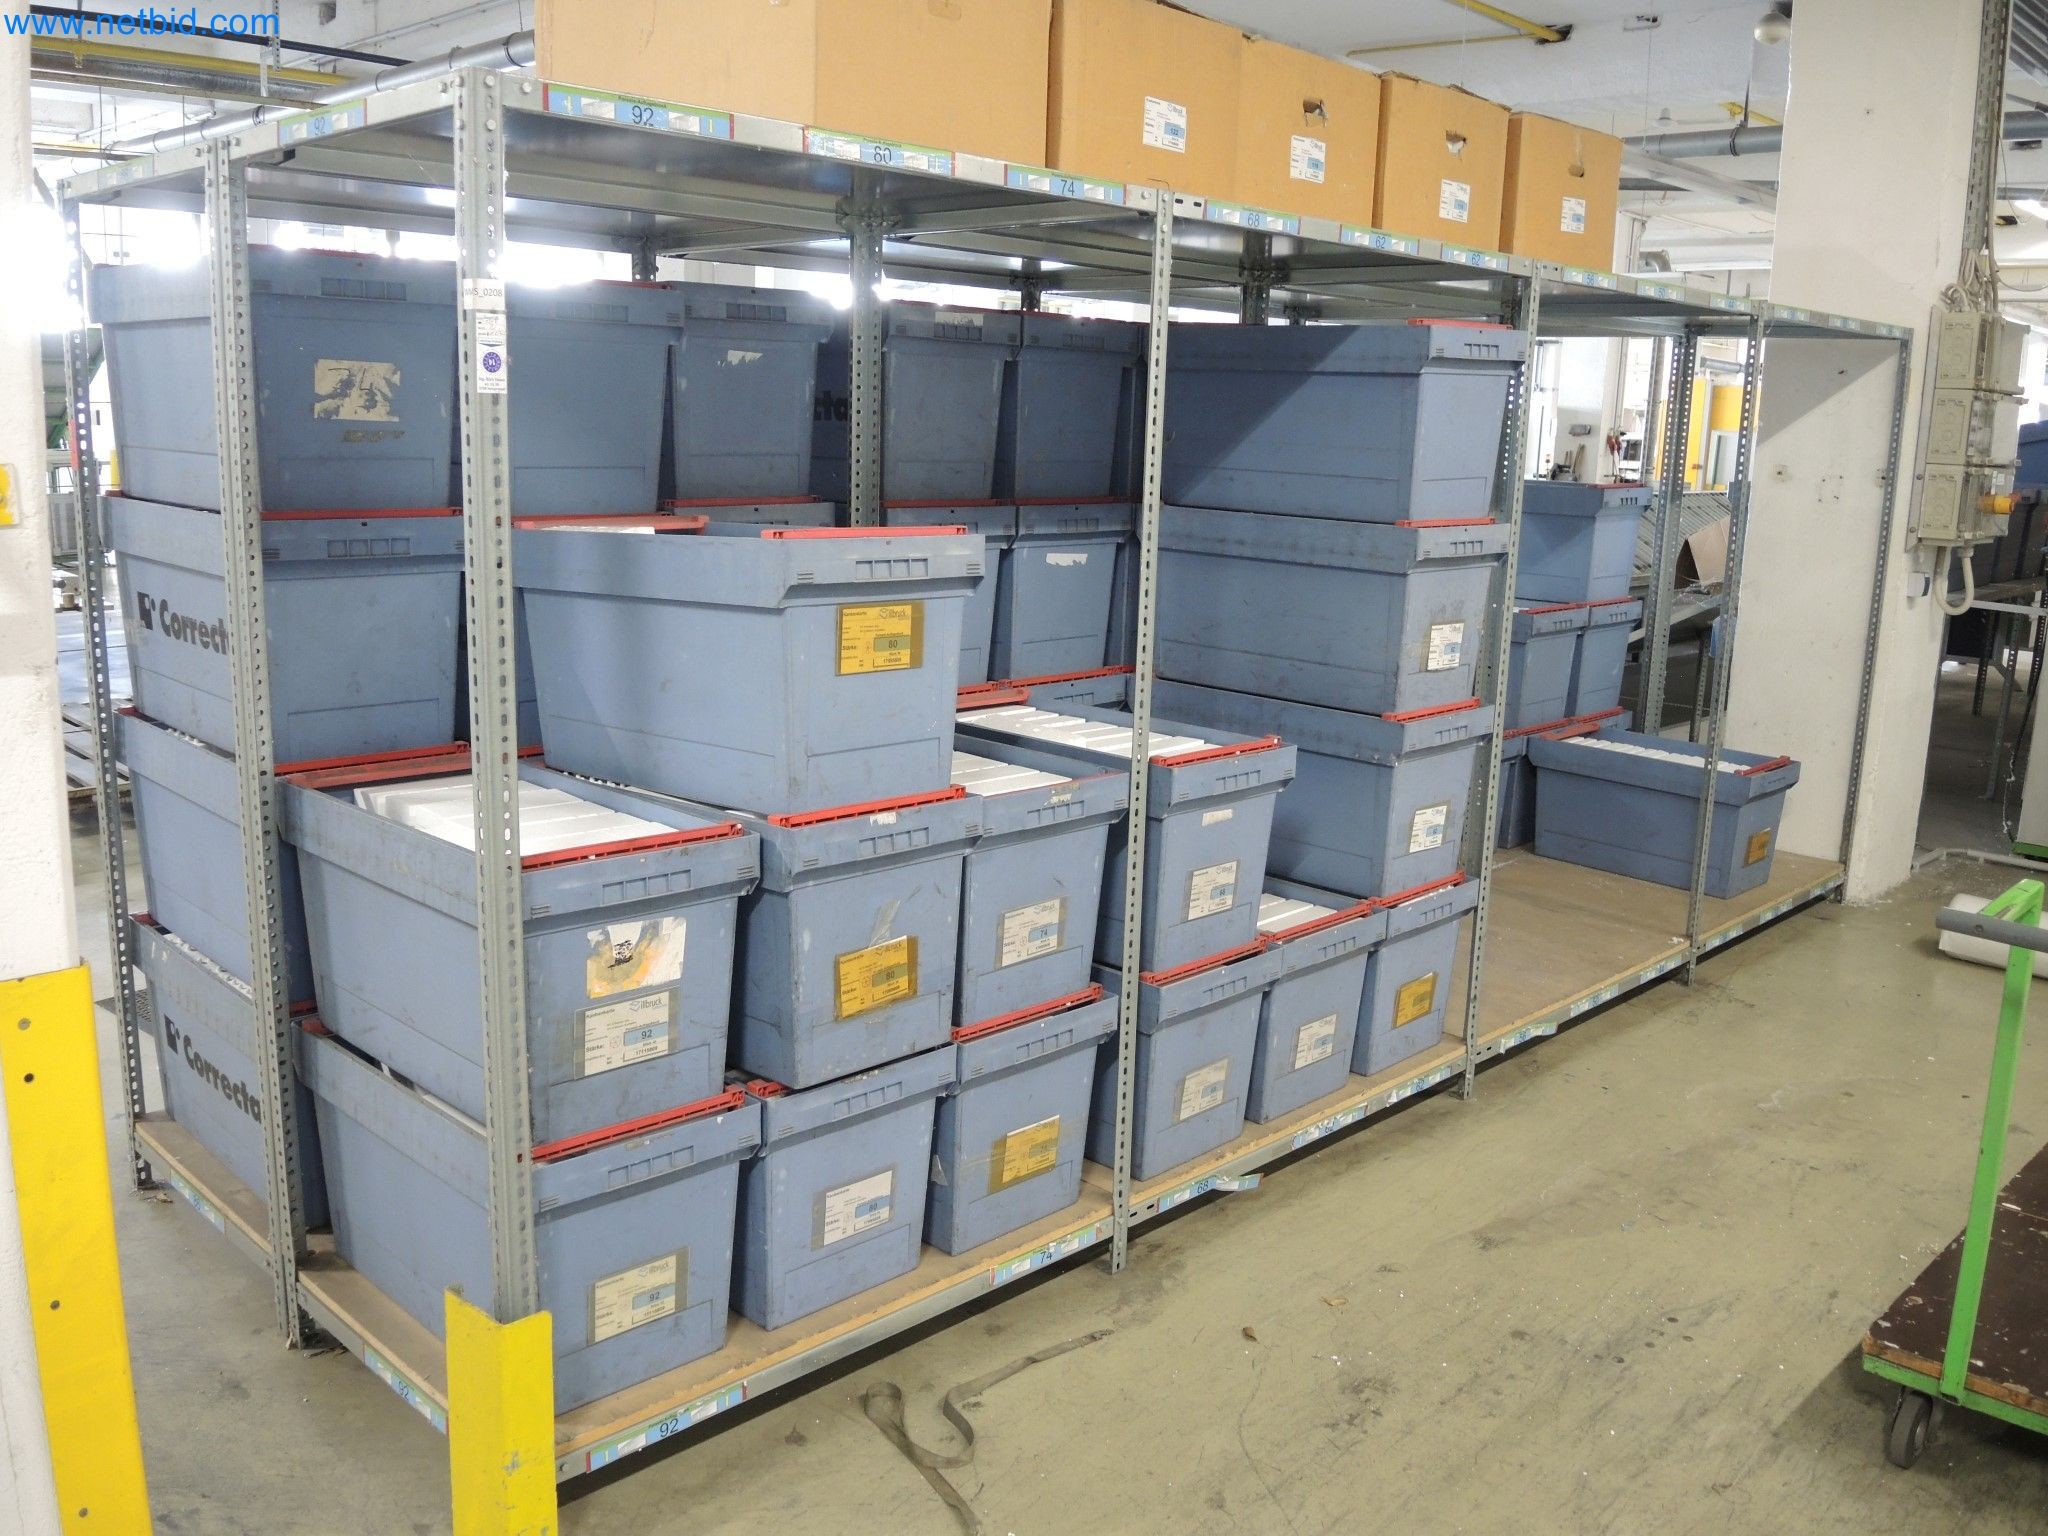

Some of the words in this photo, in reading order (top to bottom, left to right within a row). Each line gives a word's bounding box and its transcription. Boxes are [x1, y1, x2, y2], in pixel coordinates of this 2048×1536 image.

[632, 105, 655, 127] 92
[314, 116, 326, 136] 92
[1060, 179, 1075, 196] 74
[1247, 212, 1260, 228] 68
[1375, 235, 1386, 249] 62
[1471, 253, 1481, 266] 62
[159, 598, 229, 656] Correct
[888, 639, 898, 649] 80
[1040, 929, 1048, 939] 74
[641, 1029, 653, 1040] 92
[183, 1034, 262, 1125] Correcta
[1197, 1180, 1209, 1194] 68
[1040, 1251, 1053, 1264] 74
[649, 1291, 661, 1302] 92
[659, 1418, 679, 1438] 92
